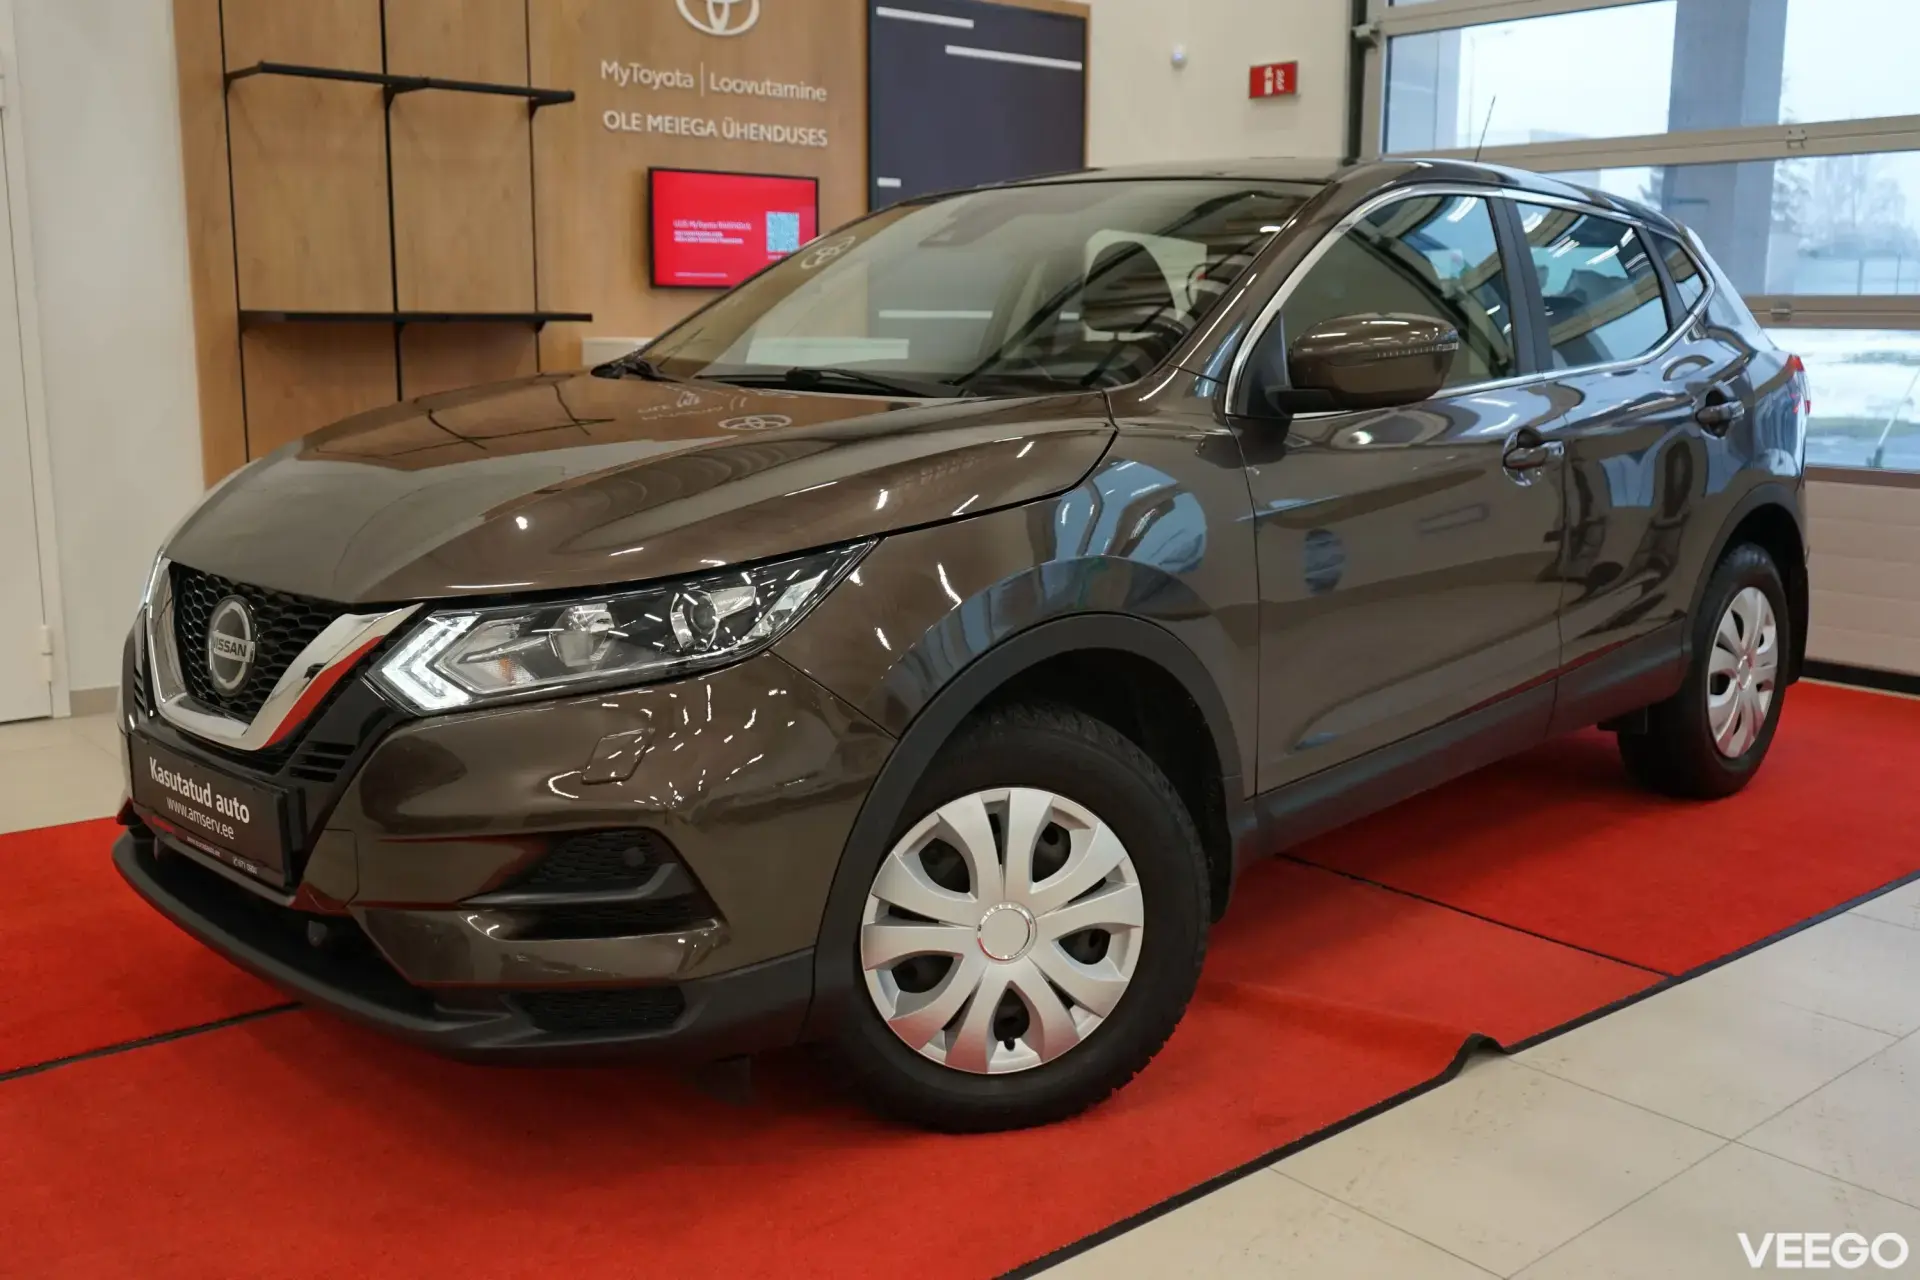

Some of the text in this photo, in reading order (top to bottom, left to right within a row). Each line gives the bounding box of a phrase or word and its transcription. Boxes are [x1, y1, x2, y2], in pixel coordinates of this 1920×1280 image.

[600, 60, 828, 101] MyToyota Loovutamine
[603, 110, 828, 147] OLE MEIEGA ÜHENDUSES
[149, 756, 250, 824] Kasutatud auto
[166, 796, 235, 840] www.amserv.ee
